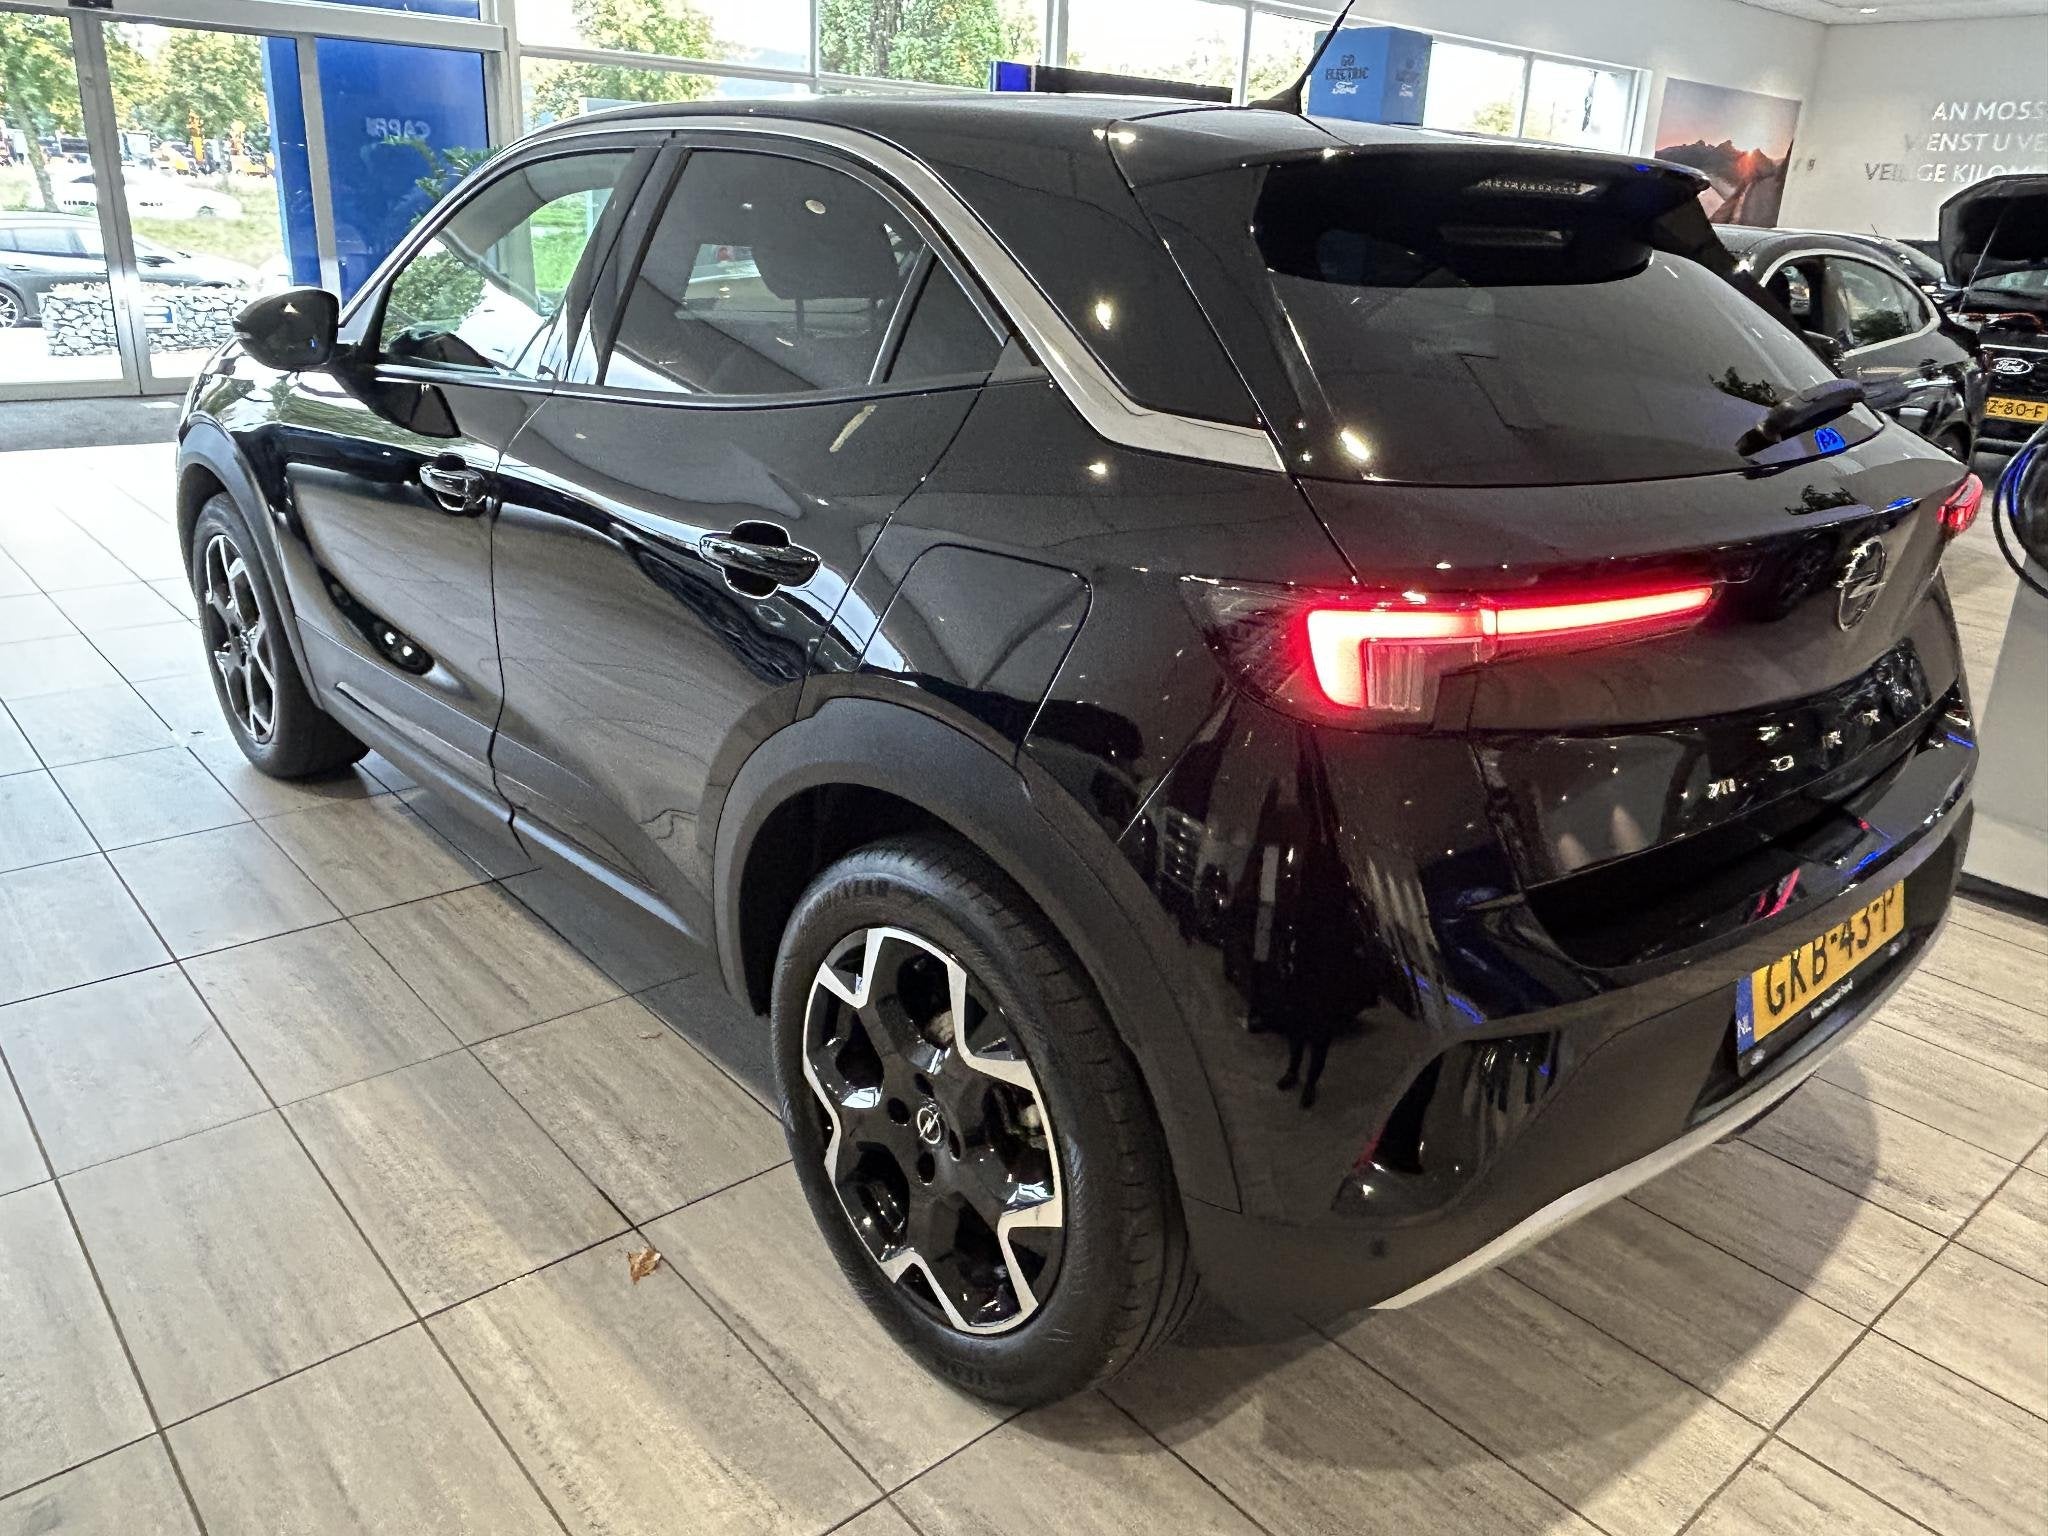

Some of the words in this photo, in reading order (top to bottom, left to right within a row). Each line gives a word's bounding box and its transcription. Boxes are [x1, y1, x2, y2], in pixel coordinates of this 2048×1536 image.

[1993, 133, 2011, 152] U
[1995, 358, 2026, 373] Ford
[1736, 1017, 1752, 1037] NL
